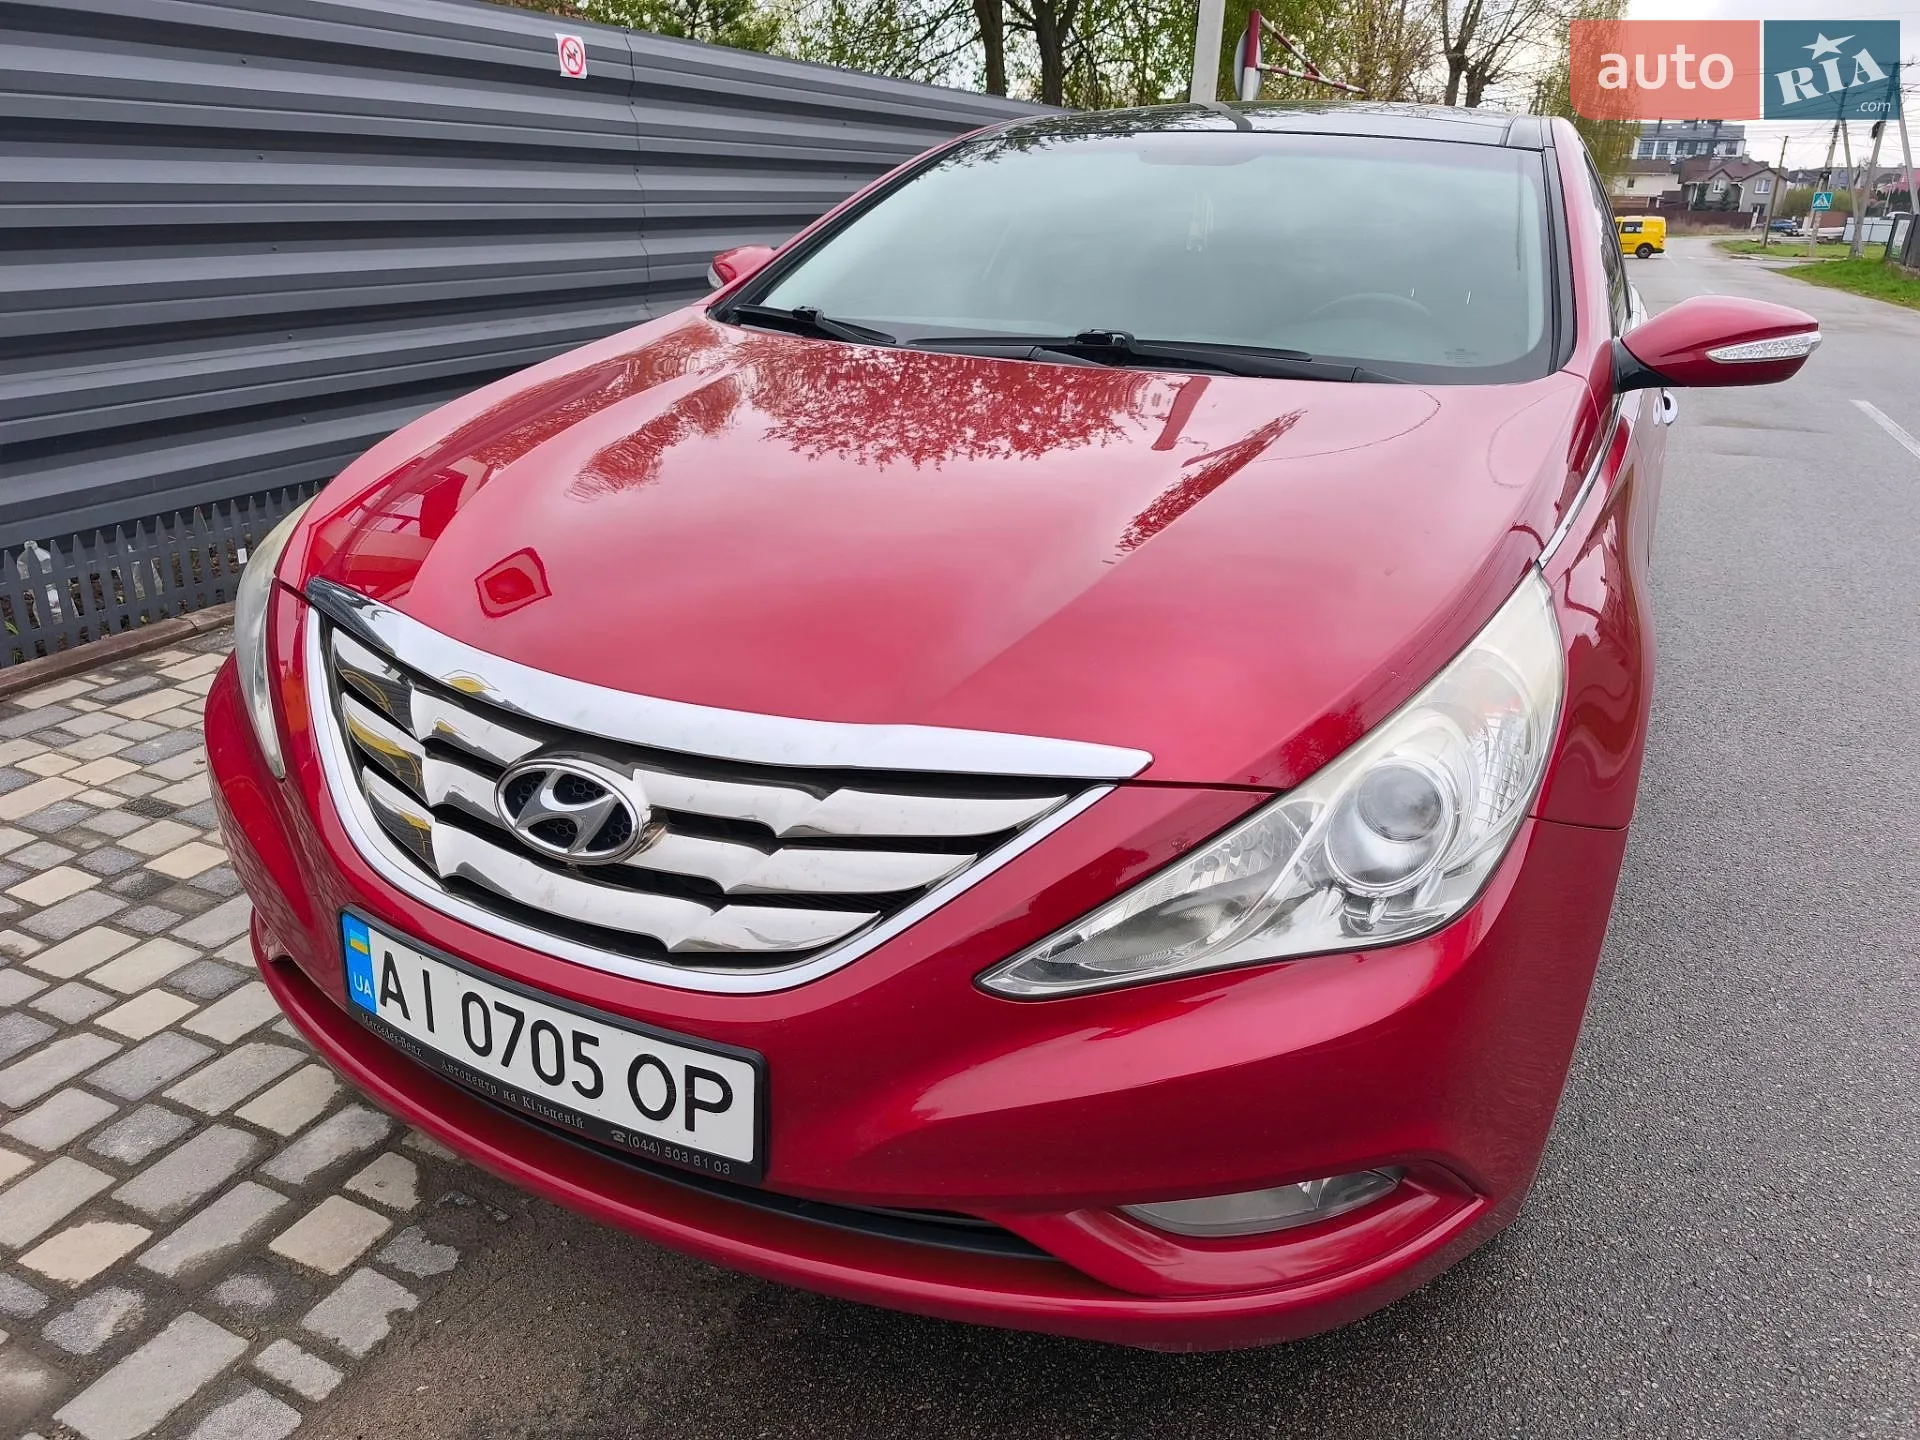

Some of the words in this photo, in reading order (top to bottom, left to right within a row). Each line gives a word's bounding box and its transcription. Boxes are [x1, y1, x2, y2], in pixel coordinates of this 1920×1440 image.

[353, 971, 373, 999] UA
[461, 991, 604, 1100] 0705
[627, 1053, 734, 1132] OP
[503, 1090, 517, 1103] на
[628, 1132, 661, 1157] (044)
[664, 1146, 689, 1164] 503
[713, 1161, 730, 1175] 03
